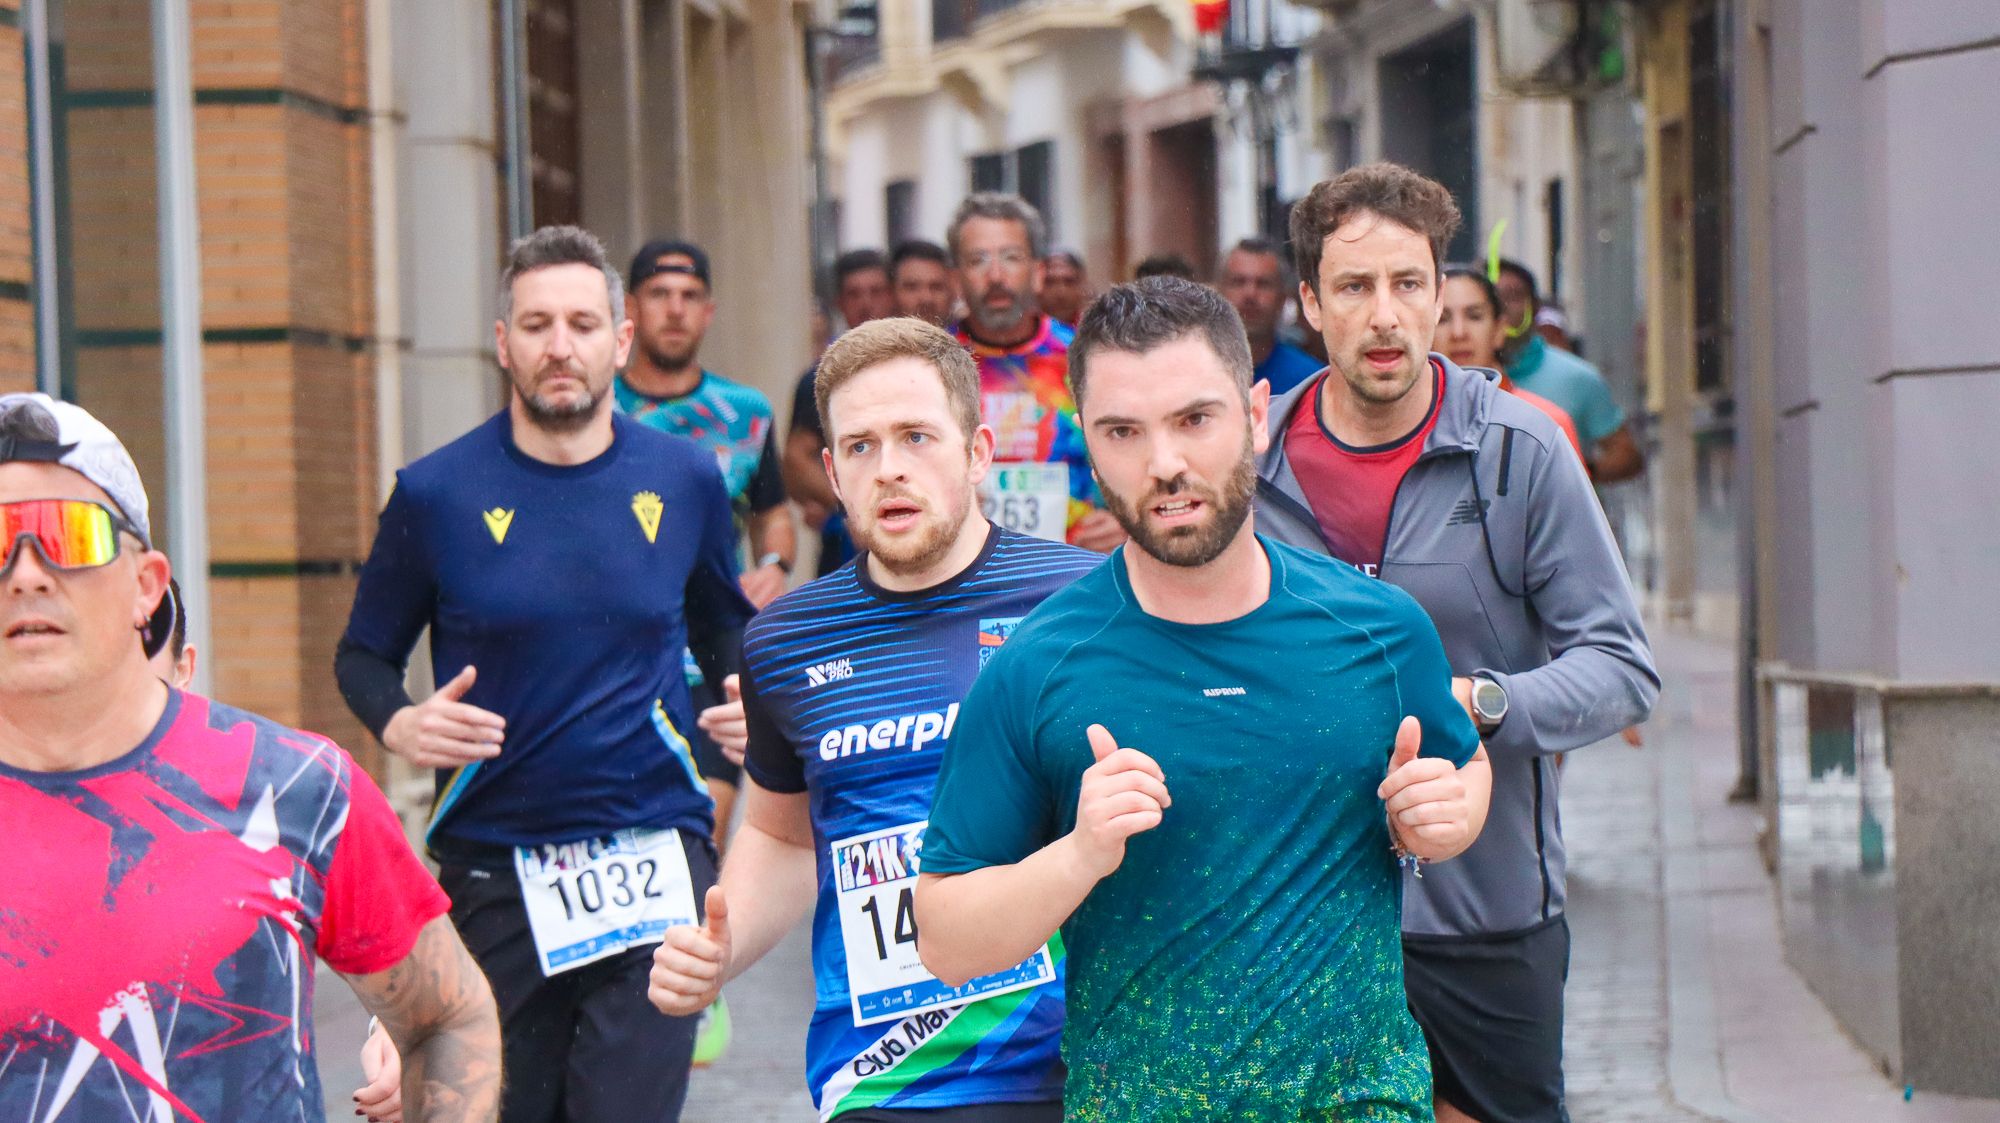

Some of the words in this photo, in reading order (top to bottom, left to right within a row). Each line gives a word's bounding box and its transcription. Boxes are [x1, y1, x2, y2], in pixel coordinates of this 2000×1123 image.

[825, 657, 850, 673] RUN
[828, 666, 853, 682] PRO
[549, 859, 663, 921] 1032
[853, 1038, 906, 1077] Club
[903, 1004, 963, 1046] Mar
